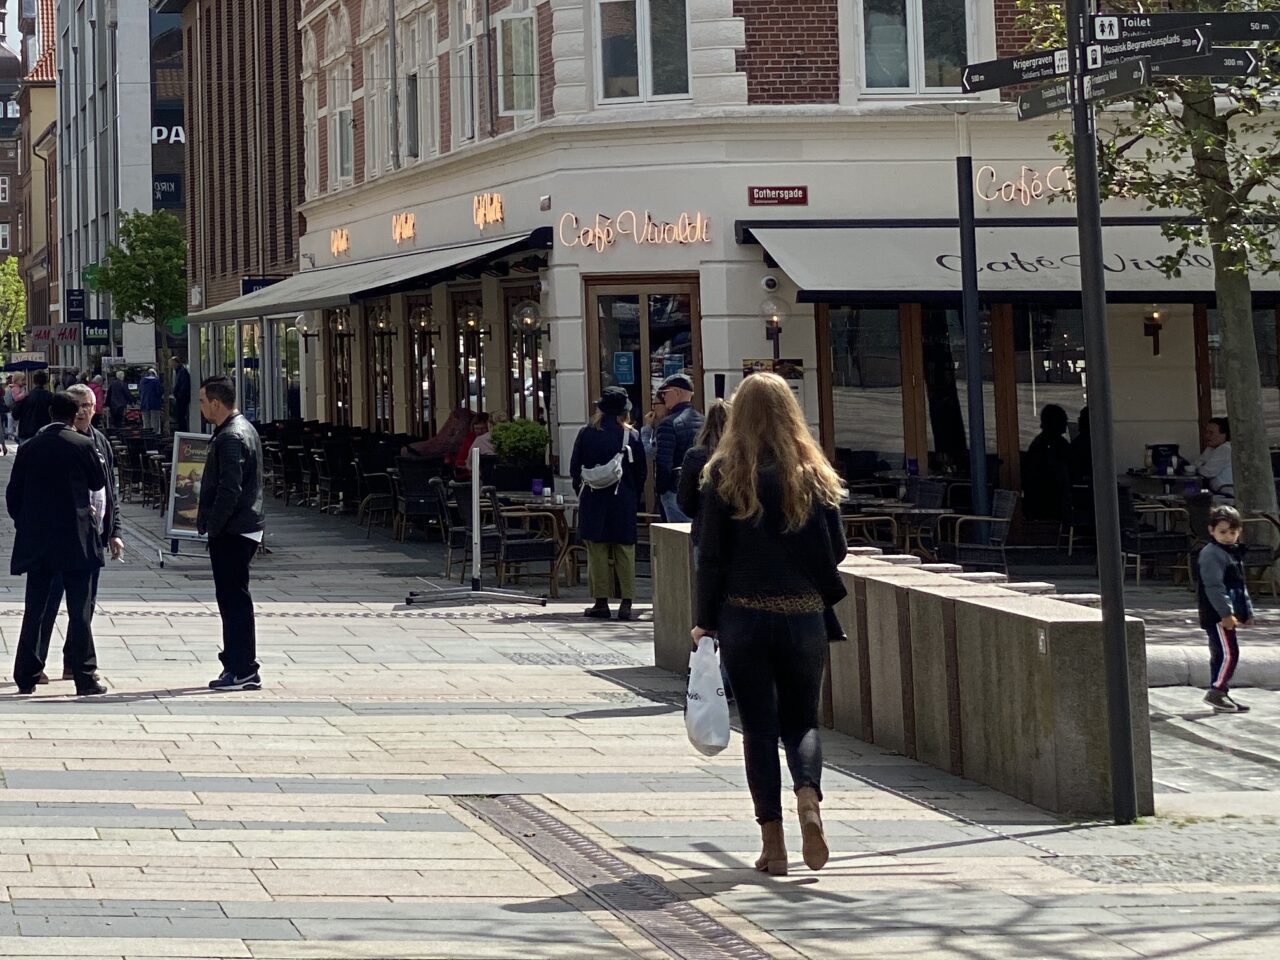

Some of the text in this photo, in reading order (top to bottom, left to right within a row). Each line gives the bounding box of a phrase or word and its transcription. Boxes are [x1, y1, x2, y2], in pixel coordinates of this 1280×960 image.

[1121, 17, 1151, 28] Toilet
[1102, 34, 1181, 54] Mosaisk Begravelsesplads
[1012, 55, 1053, 70] Krigergraven
[753, 187, 803, 200] Gothersgade
[975, 165, 1045, 207] Café
[558, 209, 712, 253] Café Vivaldi
[935, 252, 1060, 274] Café
